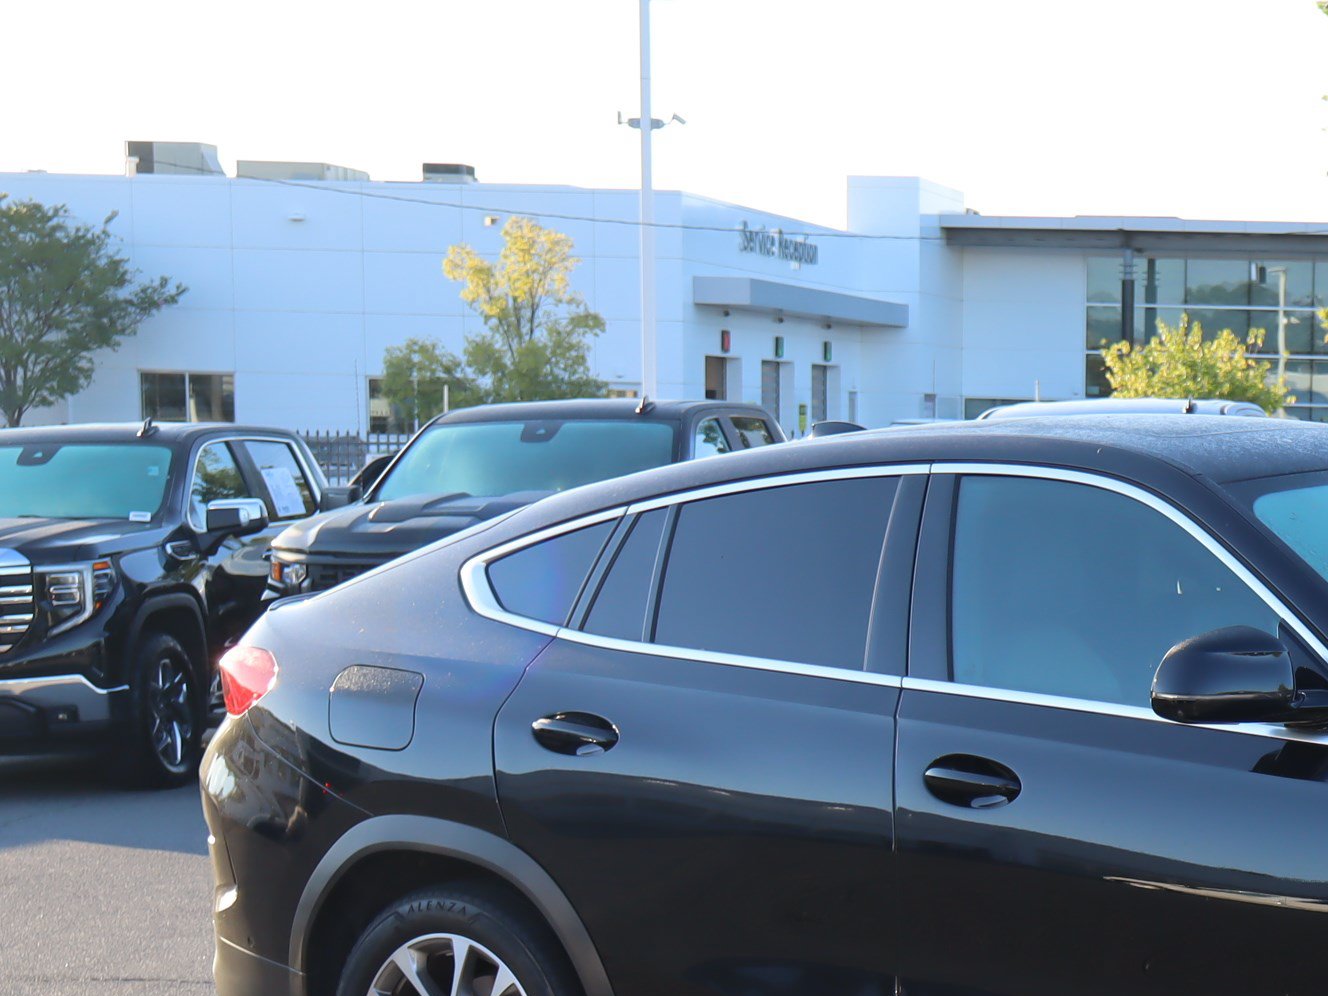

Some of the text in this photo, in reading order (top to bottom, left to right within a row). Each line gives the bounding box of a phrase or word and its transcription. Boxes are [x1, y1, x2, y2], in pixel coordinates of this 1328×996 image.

[739, 220, 819, 271] Service Reception
[407, 900, 468, 916] ALENZA
